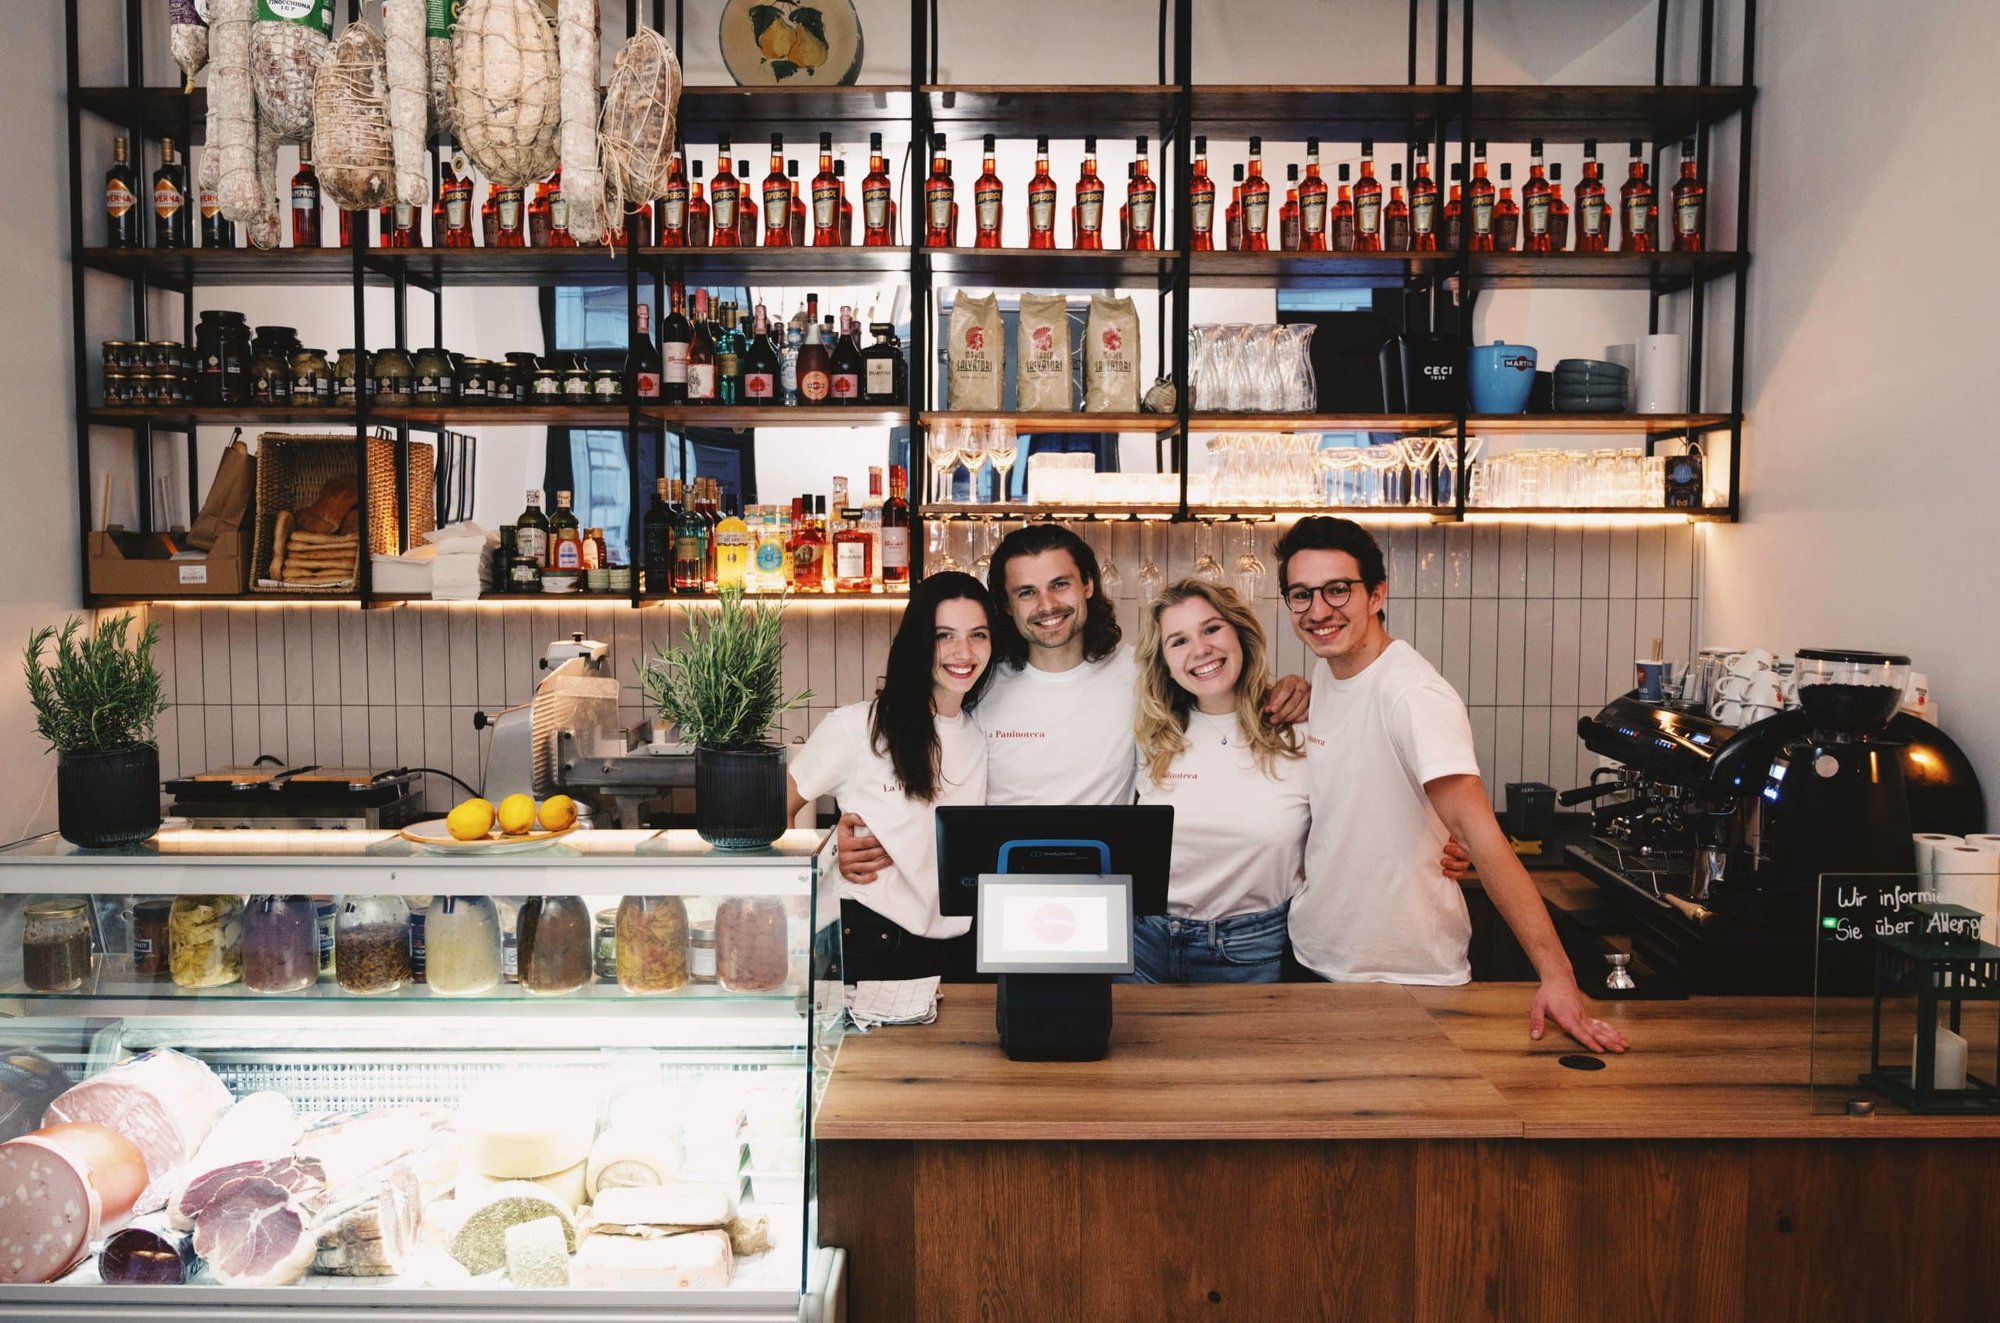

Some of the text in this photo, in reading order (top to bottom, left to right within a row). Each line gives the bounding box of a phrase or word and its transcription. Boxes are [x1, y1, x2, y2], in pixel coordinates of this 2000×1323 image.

[713, 190, 736, 200] APEROL
[765, 190, 788, 200] APEROL
[813, 190, 836, 200] APEROL
[864, 190, 888, 200] APEROL
[1423, 366, 1452, 375] CECI
[995, 730, 1045, 738] Paninoteca
[883, 784, 895, 792] La
[1837, 886, 1867, 908] Wir
[1835, 911, 1981, 941] Sie über Allerg
